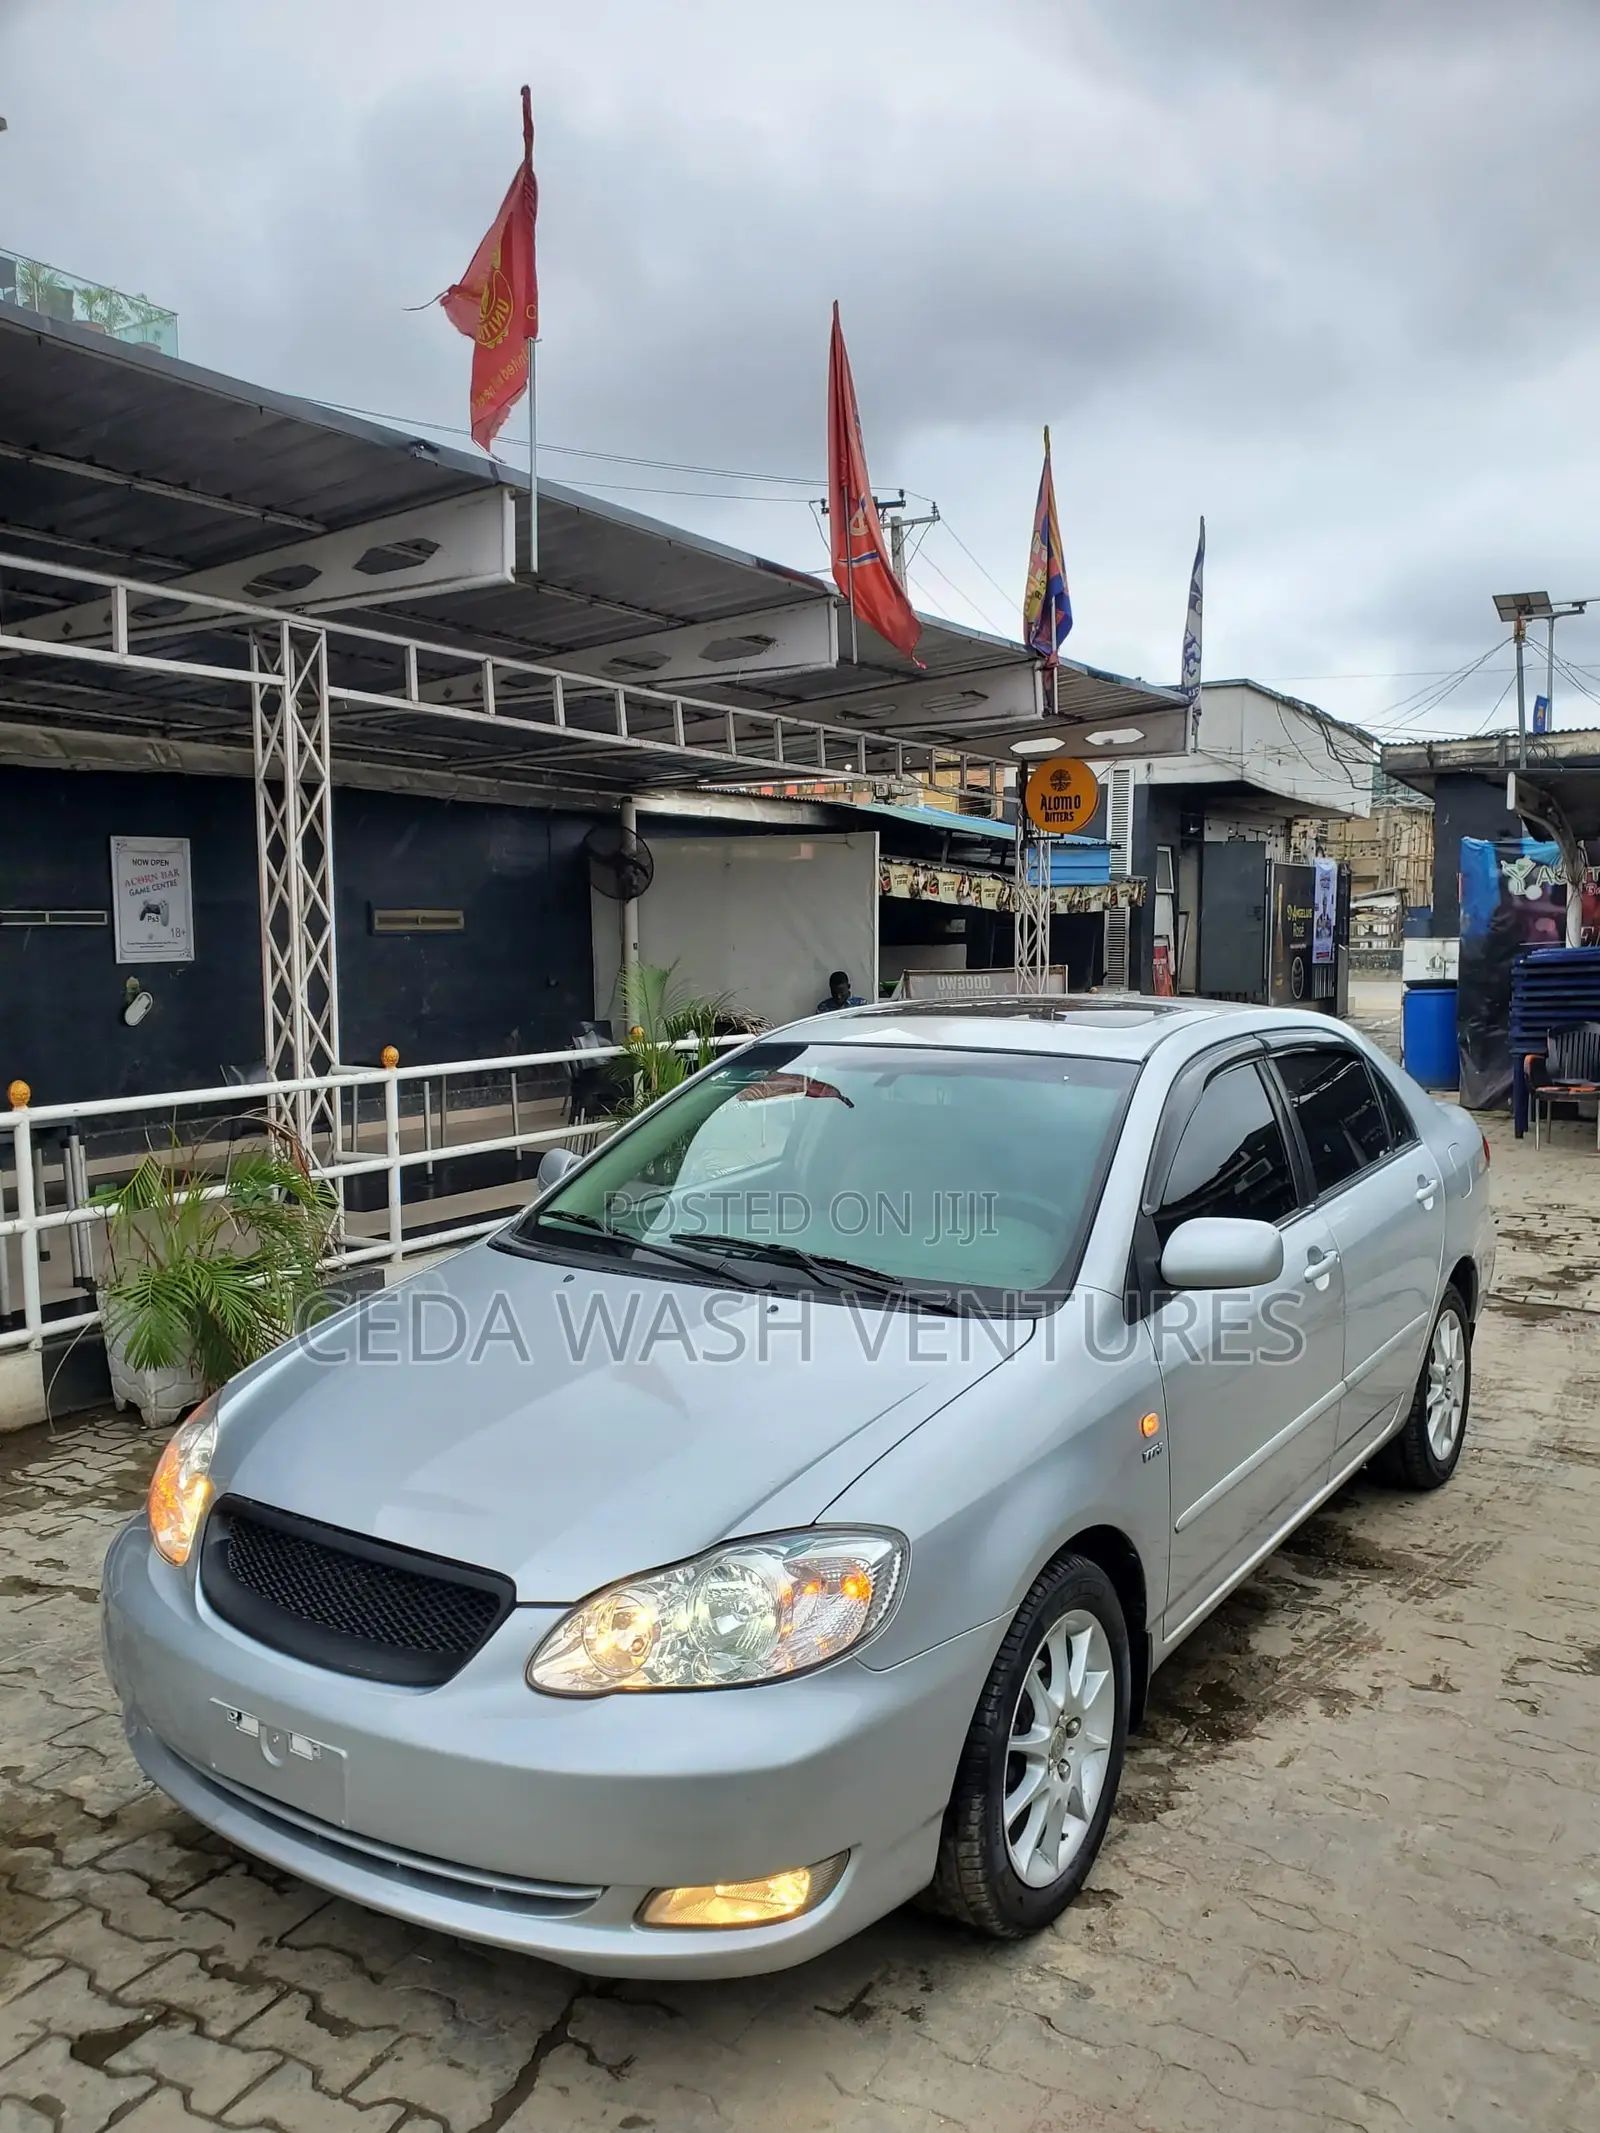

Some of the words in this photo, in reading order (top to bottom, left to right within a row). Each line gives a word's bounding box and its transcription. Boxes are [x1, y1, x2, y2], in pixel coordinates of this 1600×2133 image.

[1041, 793, 1081, 811] ALOMO
[1044, 811, 1075, 823] BITTERS
[132, 858, 148, 866] NOW
[161, 868, 180, 880] BAR
[129, 886, 150, 896] GAME
[152, 879, 177, 891] CENTRE
[170, 927, 186, 938] 18+
